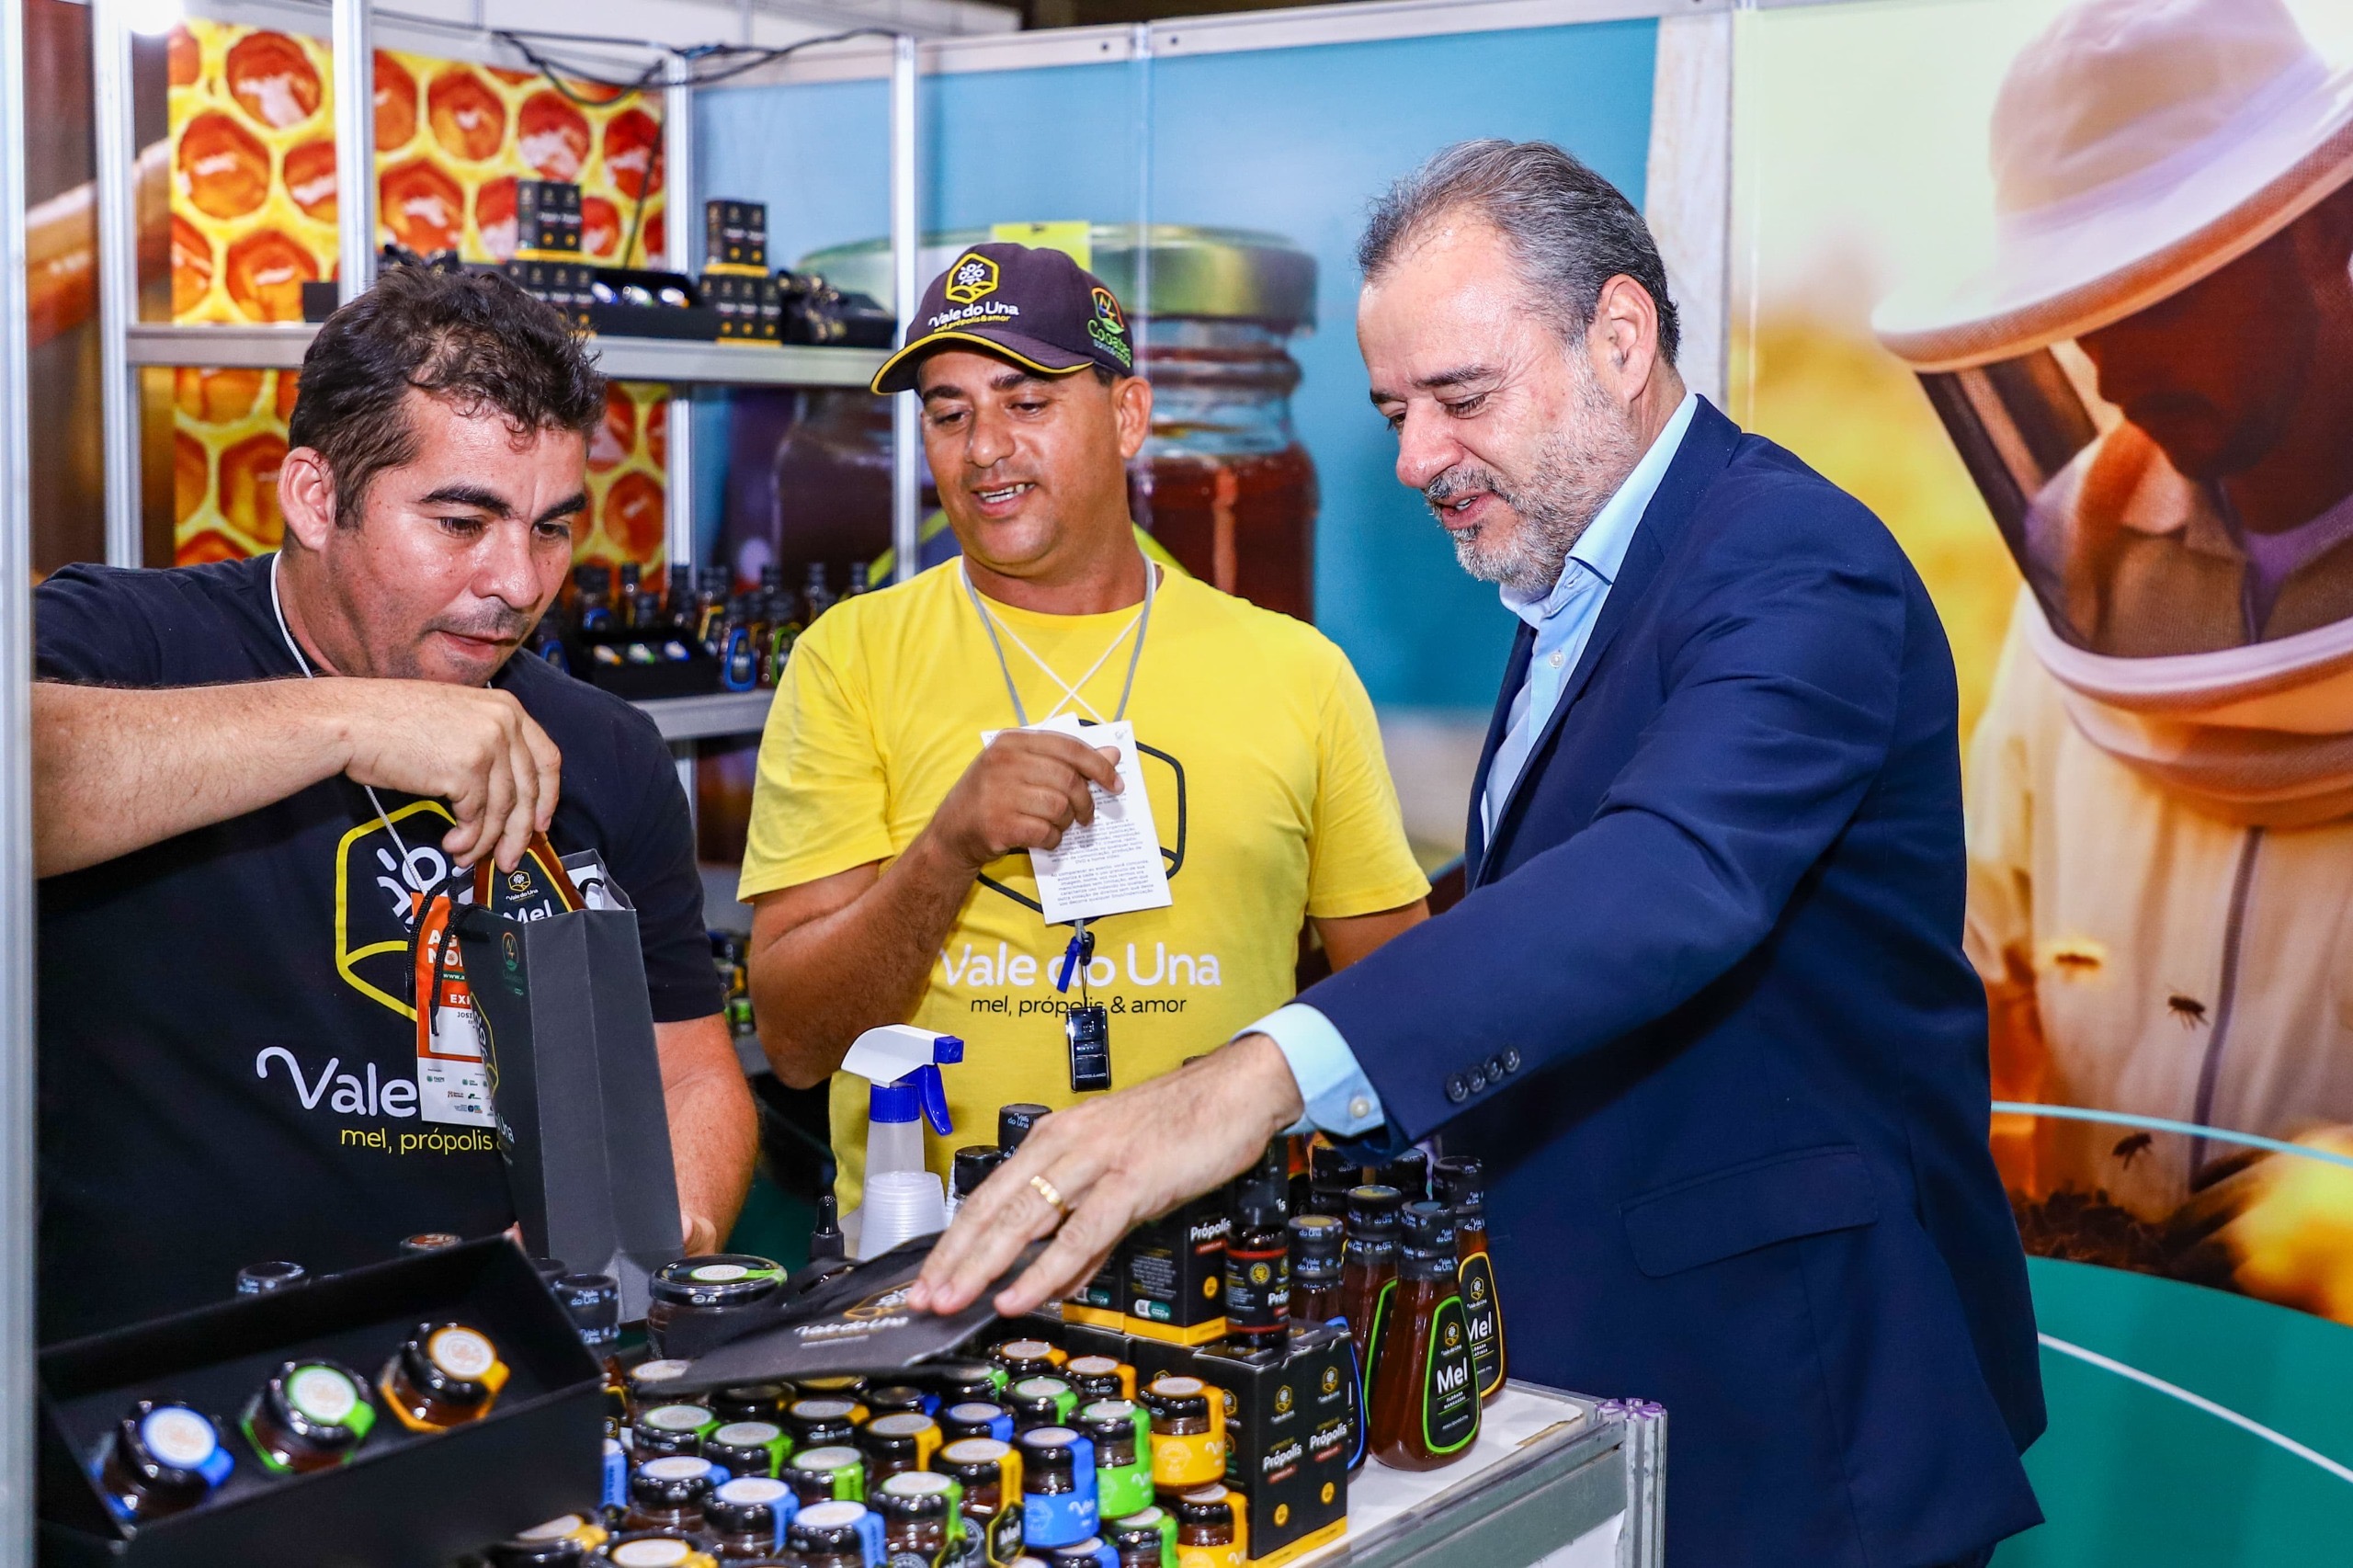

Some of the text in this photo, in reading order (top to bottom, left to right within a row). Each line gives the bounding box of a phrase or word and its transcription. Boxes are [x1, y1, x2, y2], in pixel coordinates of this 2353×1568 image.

[928, 301, 1019, 327] Vale do Una
[504, 899, 553, 924] Mel
[939, 942, 1036, 987] Vale
[1126, 942, 1221, 987] Una
[972, 995, 1186, 1017] mel, própolis & amor
[256, 1046, 418, 1117] Vale
[341, 1128, 392, 1154] mel,
[400, 1128, 493, 1155] própolis
[1190, 1217, 1232, 1241] Própolis
[1470, 1311, 1492, 1342] Mel
[1436, 1356, 1468, 1394] Mel
[1310, 1423, 1347, 1450] Própolis
[1263, 1443, 1302, 1472] Própolis
